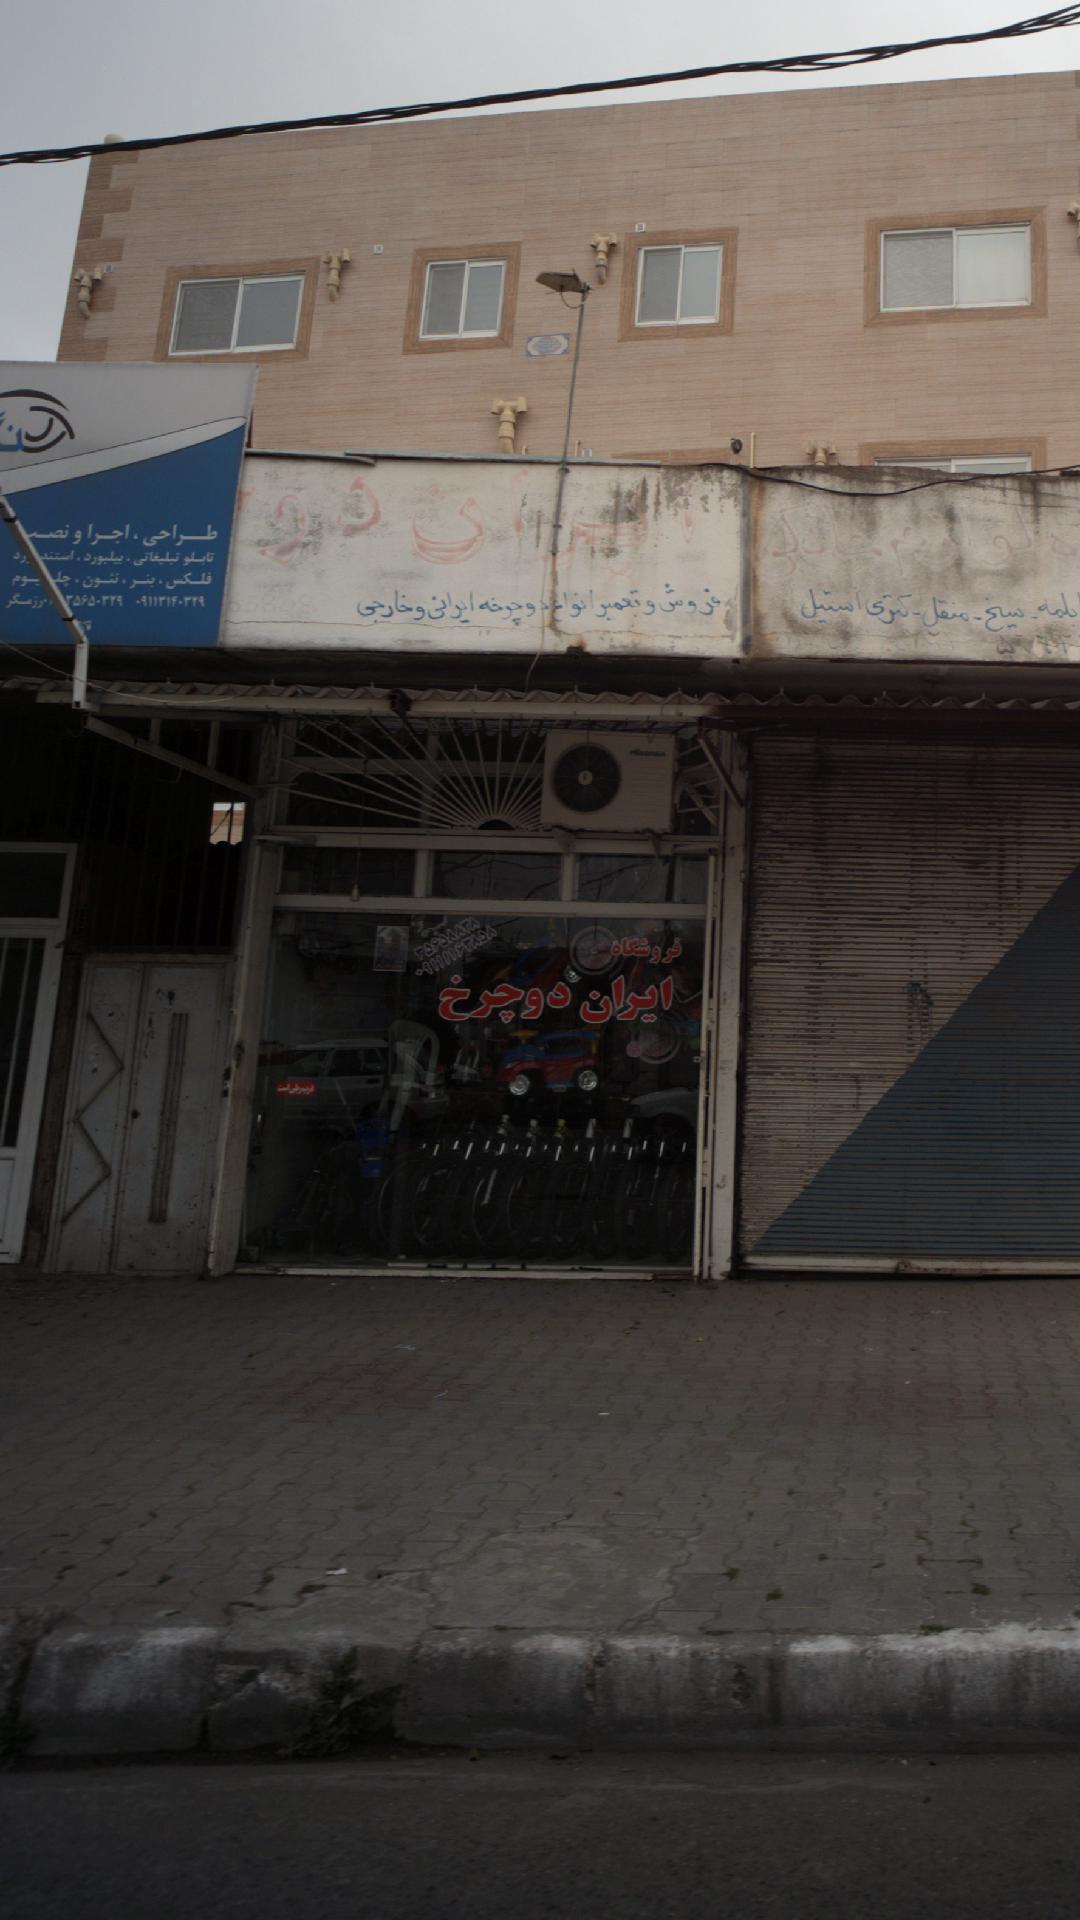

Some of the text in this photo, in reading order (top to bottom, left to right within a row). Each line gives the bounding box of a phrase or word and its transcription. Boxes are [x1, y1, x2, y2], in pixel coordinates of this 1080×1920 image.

[72, 529, 82, 545] و
[87, 523, 130, 545] اجرا
[143, 523, 218, 546] طراحی
[133, 551, 180, 566] تبلیغاتی
[183, 551, 215, 566] تابلو
[12, 571, 71, 588] چلیوم
[130, 575, 155, 589] بنر
[166, 572, 212, 589] فلکس
[357, 590, 412, 624] خارجی
[428, 591, 474, 624] ایرانی
[596, 589, 640, 621] تعمیر
[642, 599, 656, 616] و
[660, 583, 721, 616] فروش
[414, 603, 426, 621] و
[985, 597, 1025, 633] سیخ
[610, 936, 682, 964] فروشگاه
[580, 974, 674, 1024] ایران
